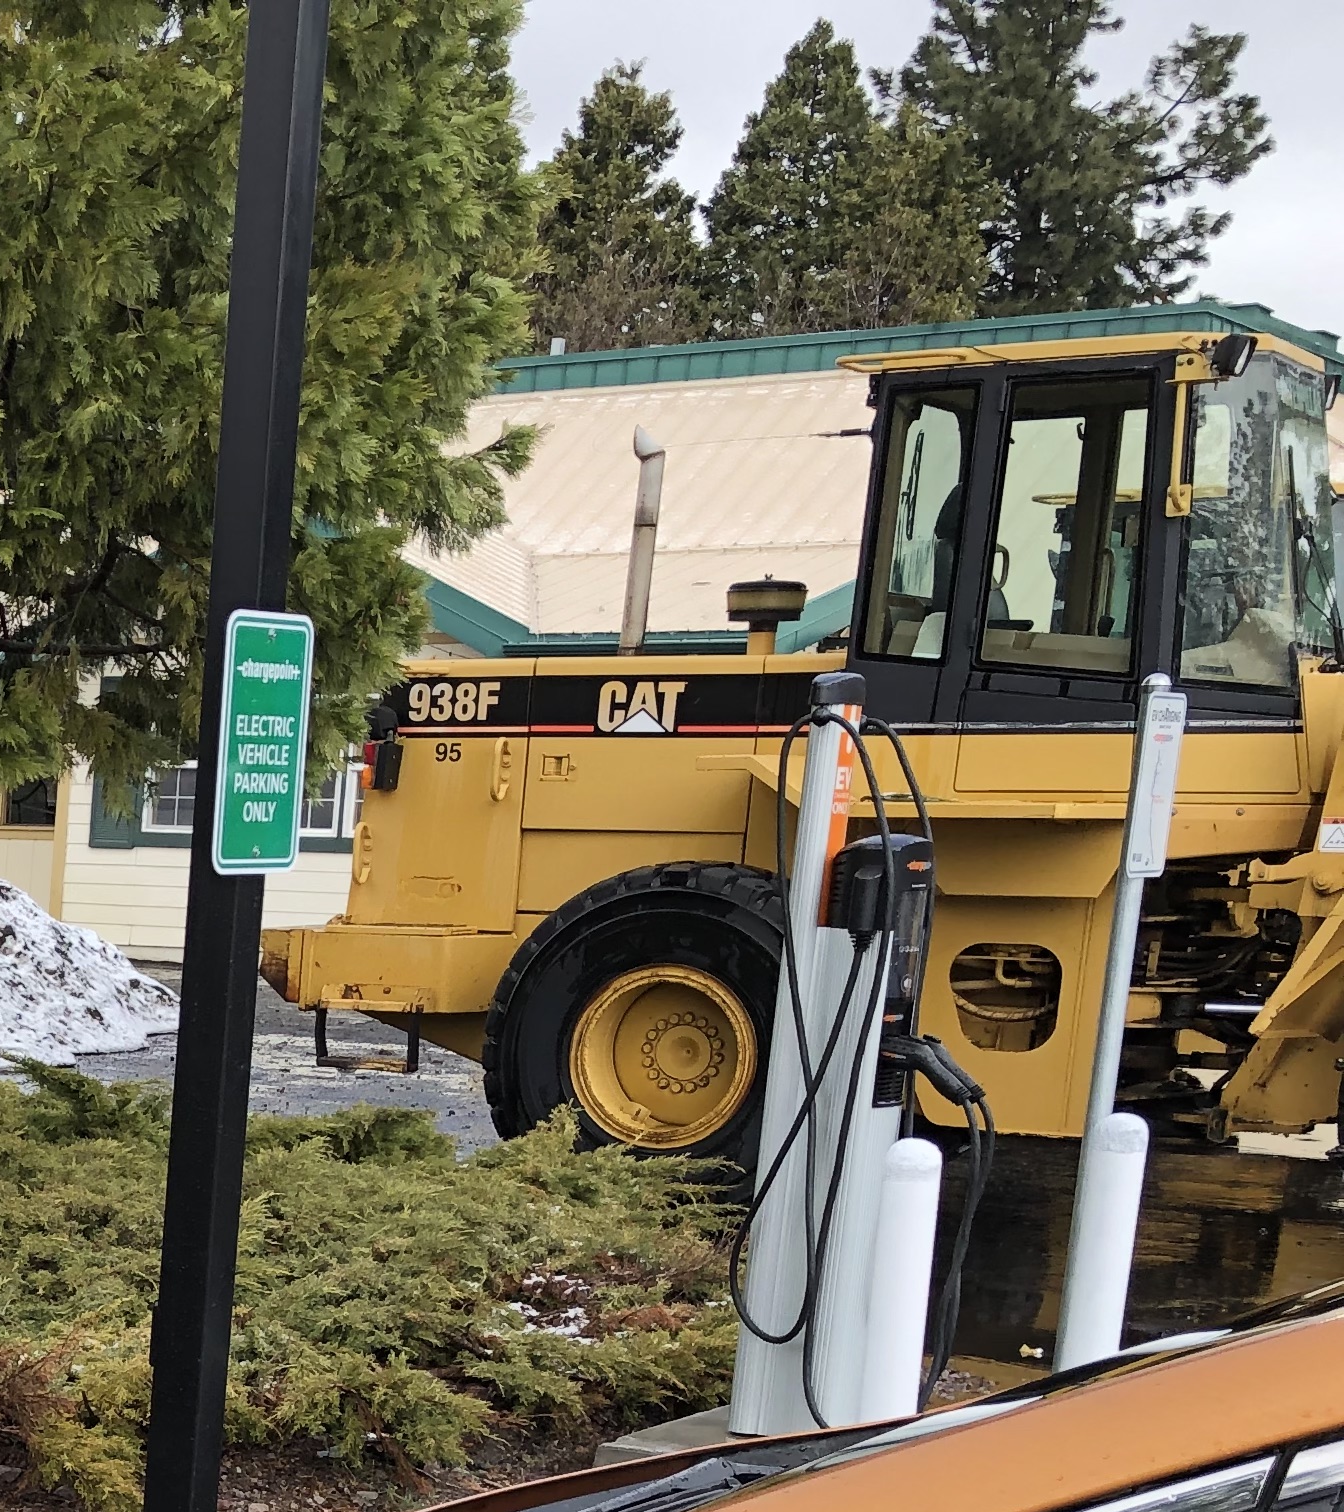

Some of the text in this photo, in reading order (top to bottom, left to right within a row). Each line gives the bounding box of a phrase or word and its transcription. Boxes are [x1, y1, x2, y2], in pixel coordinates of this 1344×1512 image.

[408, 681, 501, 722] 938F
[597, 681, 687, 732] CAT
[236, 714, 295, 738] ELECTRIC
[238, 744, 289, 766] VEHICLE
[435, 743, 462, 762] 95
[234, 773, 288, 794] PARKING
[243, 801, 277, 823] ONLY
